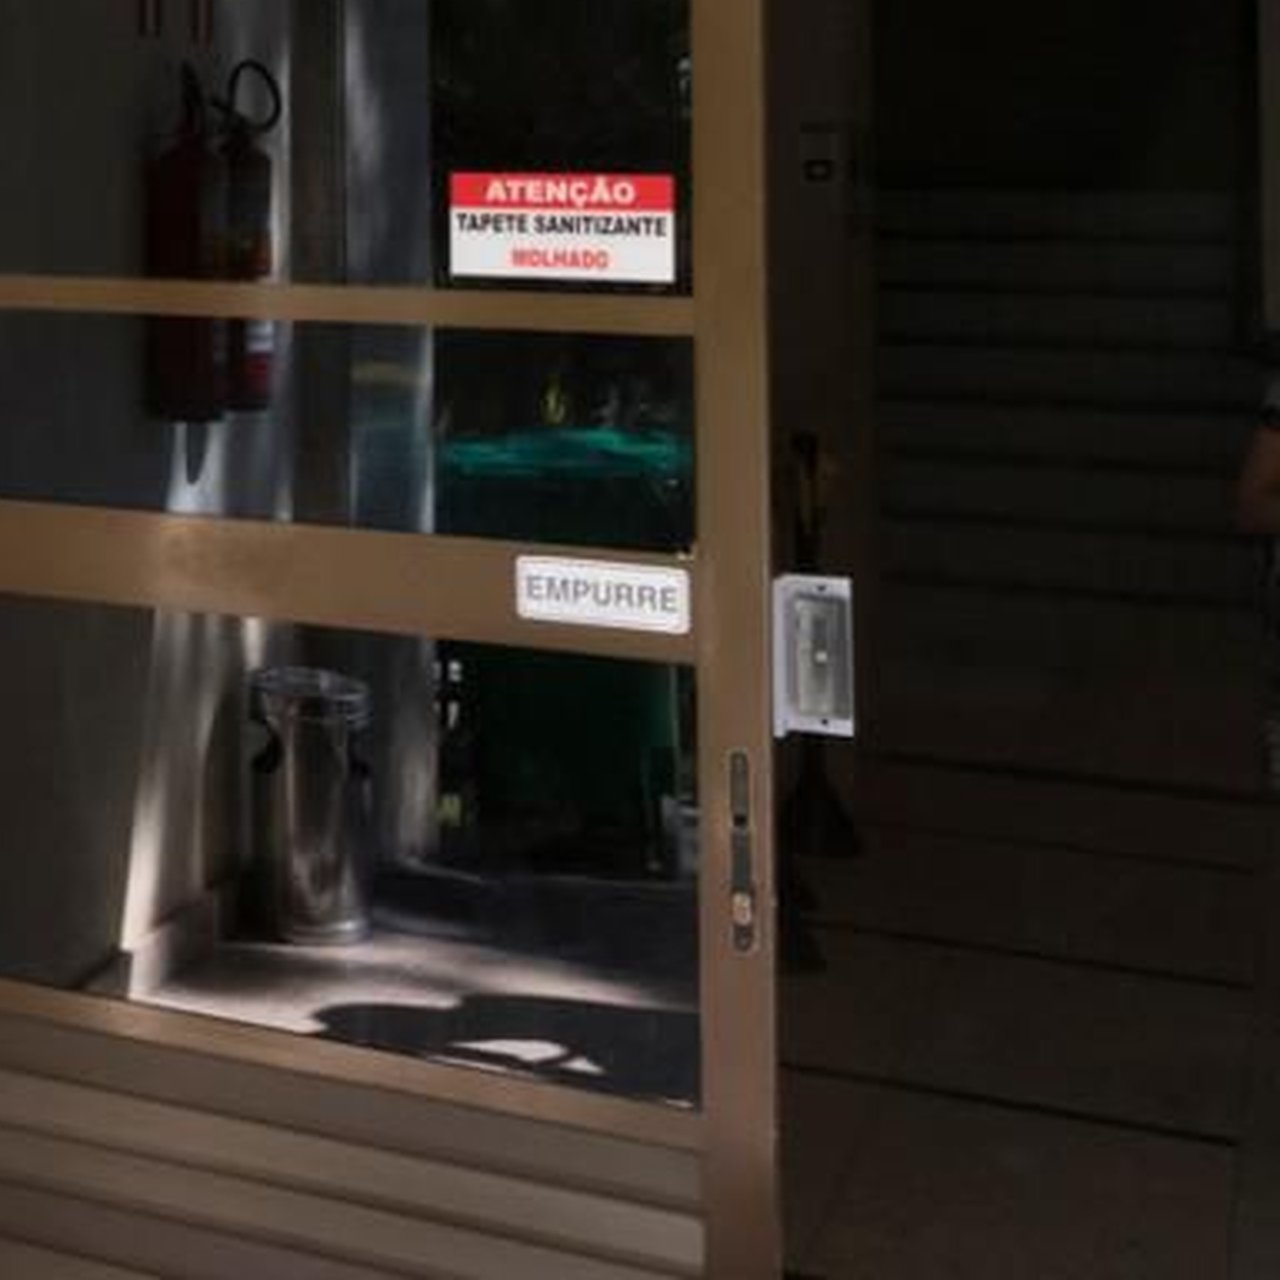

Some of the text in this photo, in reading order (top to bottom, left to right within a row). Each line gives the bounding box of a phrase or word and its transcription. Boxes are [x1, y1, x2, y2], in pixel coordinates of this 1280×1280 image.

[486, 177, 636, 207] ATENÇÃO
[456, 213, 667, 237] TAPETE SANITIZANTE
[510, 249, 609, 269] MOLHADO
[526, 575, 679, 613] EMPURRE
